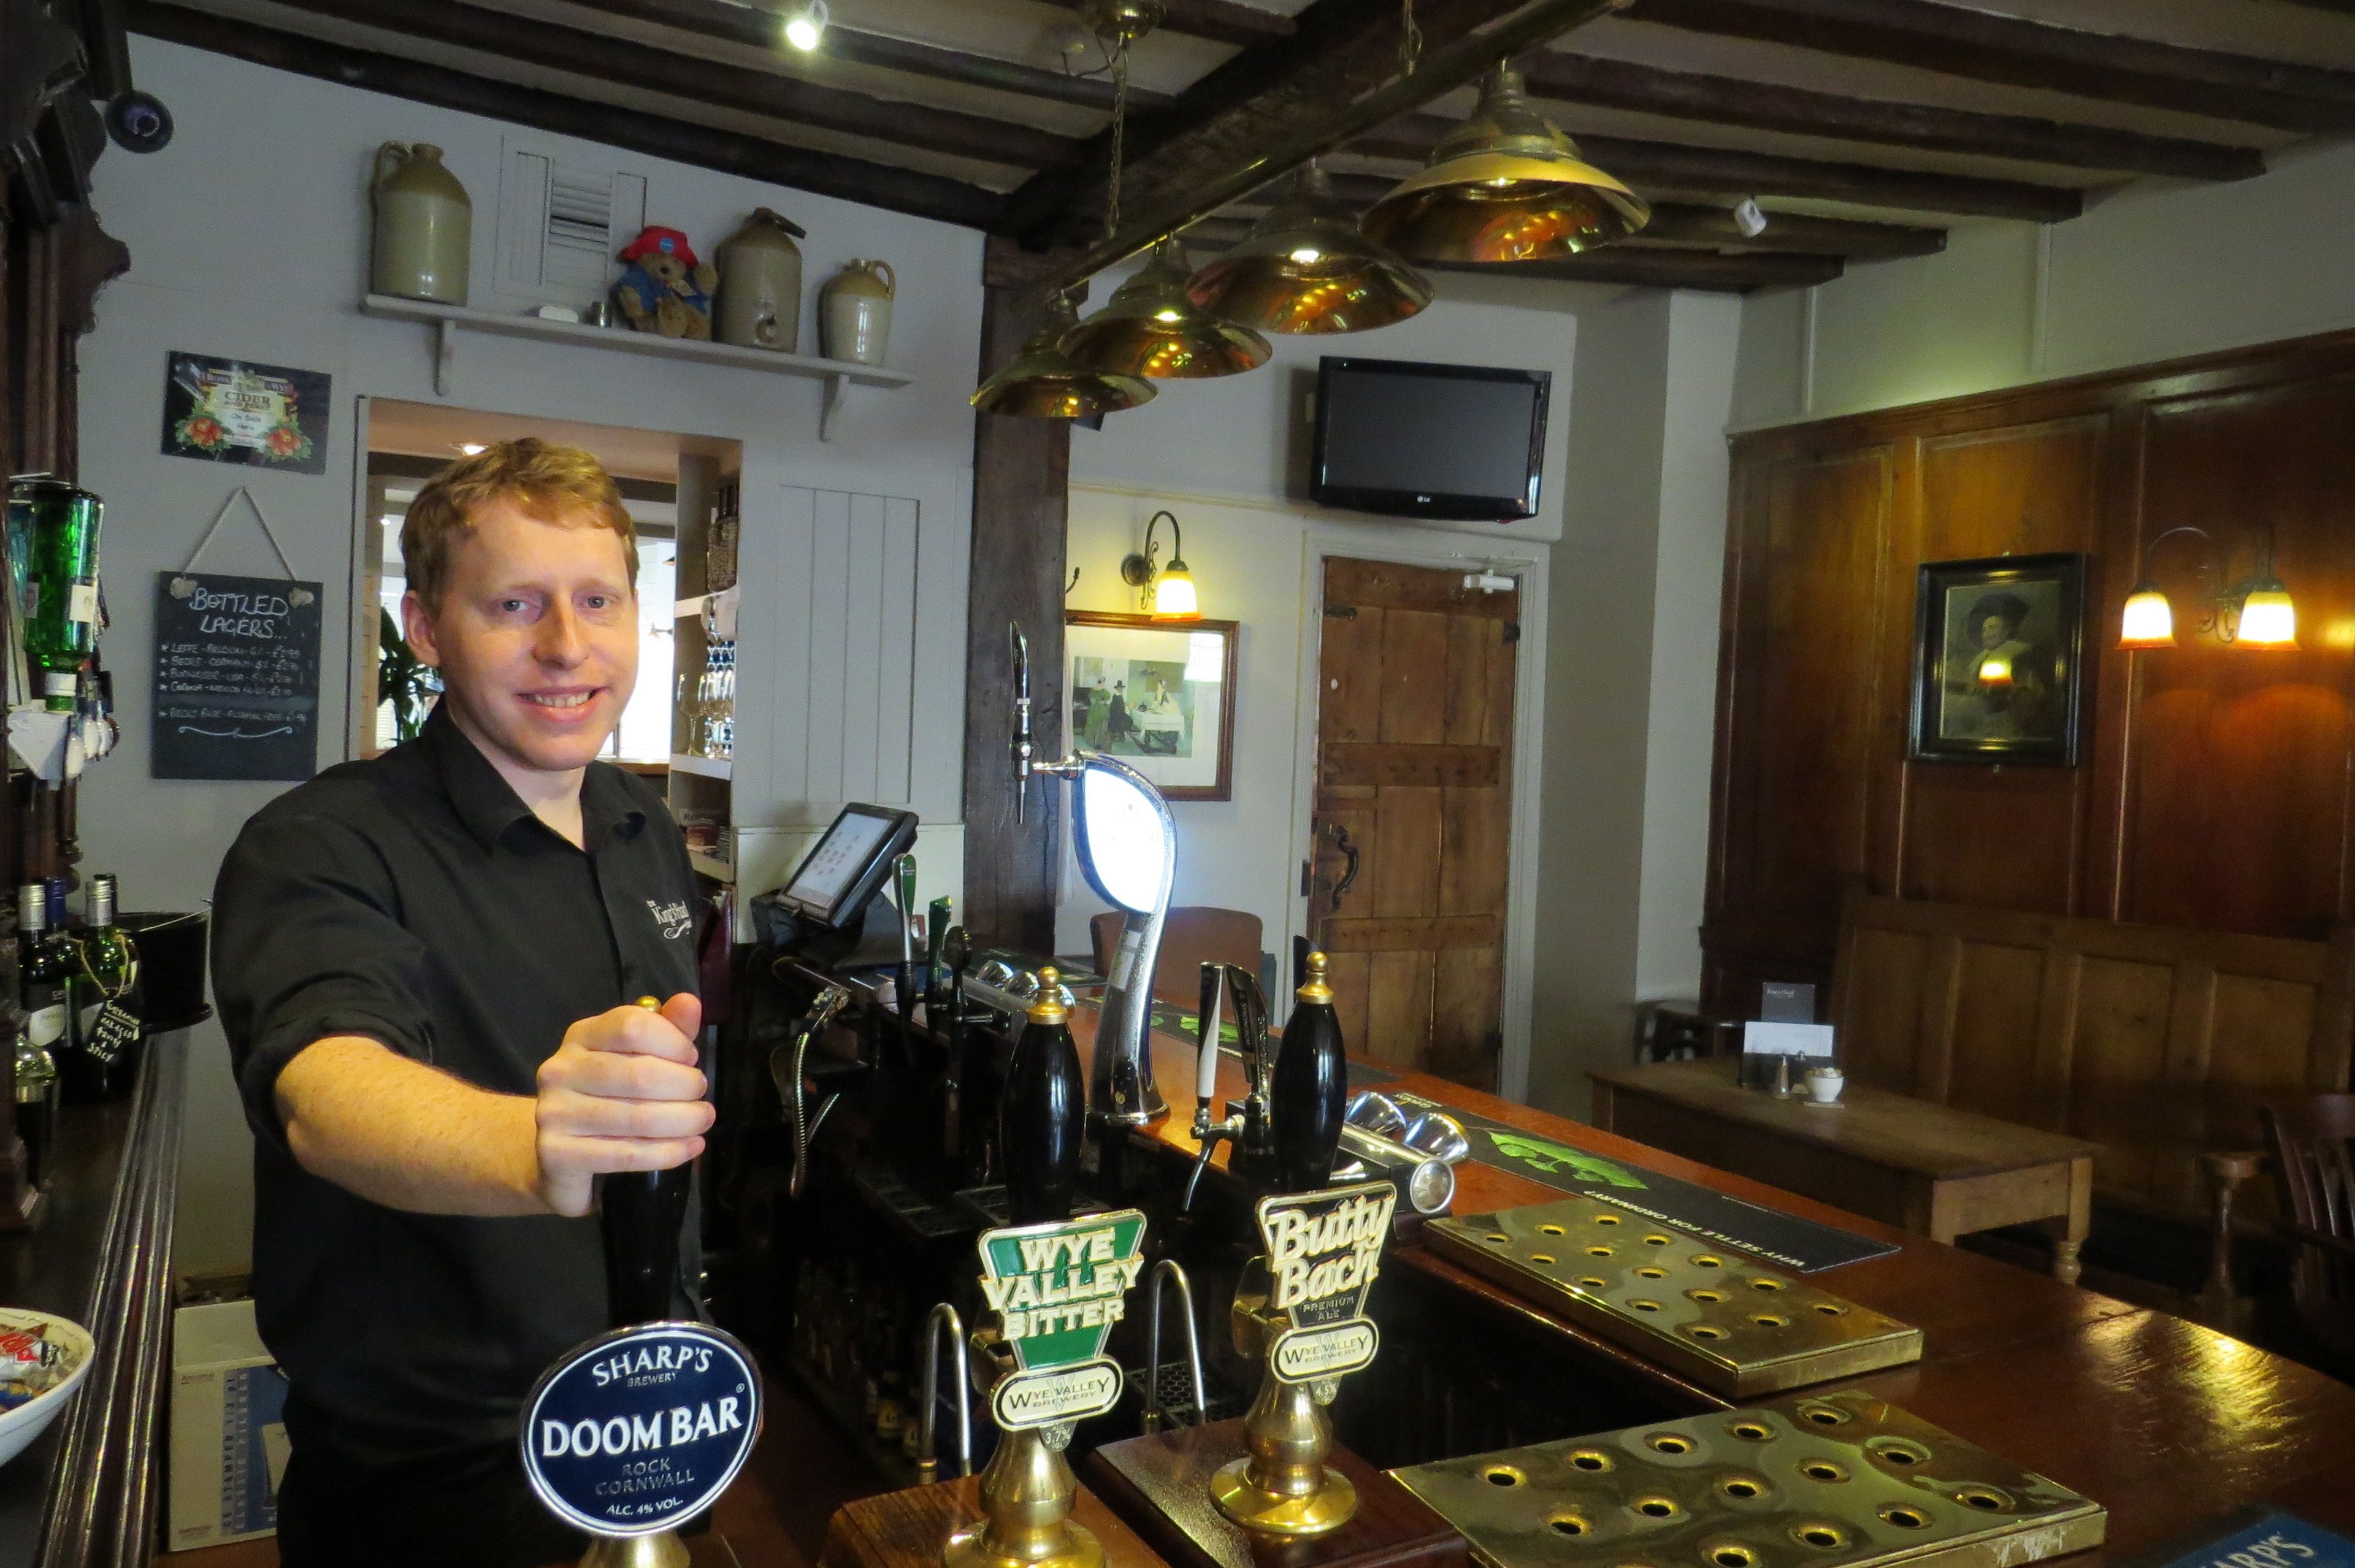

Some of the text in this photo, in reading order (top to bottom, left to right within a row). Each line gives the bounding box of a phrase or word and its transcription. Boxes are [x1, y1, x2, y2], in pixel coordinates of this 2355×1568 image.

[189, 587, 288, 616] BOTTLED
[1267, 1195, 1395, 1264] Butty
[1668, 1218, 1702, 1232] FOR
[1019, 1226, 1116, 1272] WYE
[1701, 1230, 1763, 1252] SETTLE
[1761, 1252, 1806, 1267] WHY
[978, 1252, 1144, 1310] VALLEY
[1272, 1241, 1379, 1310] Bach
[1303, 1296, 1354, 1313] PREMIUM
[1317, 1309, 1340, 1321] ALE
[1002, 1295, 1125, 1340] BITTER
[1322, 1334, 1368, 1352] VALLEY
[592, 1345, 713, 1387] SHARP'S
[627, 1371, 678, 1388] BREWERY
[1055, 1376, 1110, 1395] VALLEY
[542, 1395, 743, 1458] DOOM BAR
[1045, 1429, 1071, 1445] 3.7%
[622, 1457, 671, 1477] ROCK
[595, 1469, 695, 1496] CORNWALL
[637, 1503, 654, 1515] 4%
